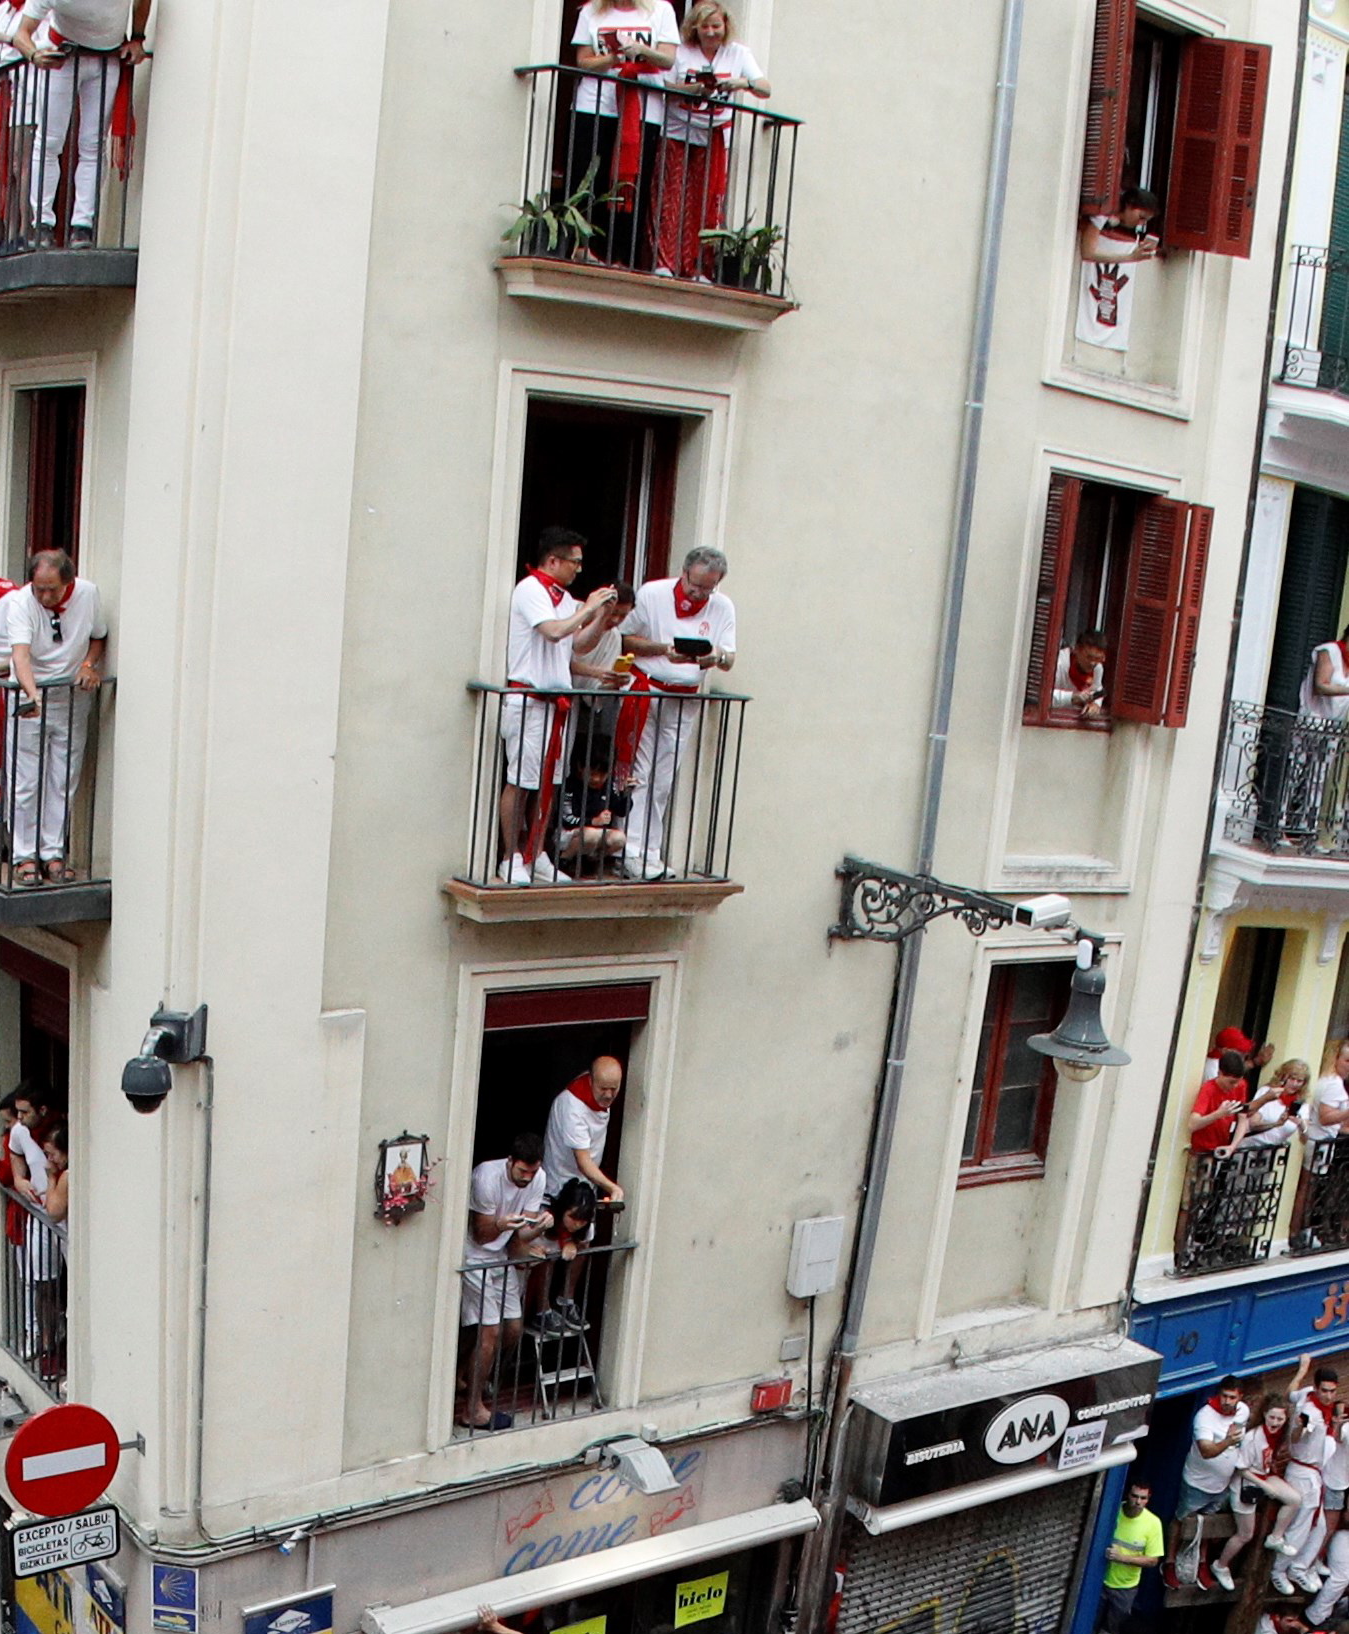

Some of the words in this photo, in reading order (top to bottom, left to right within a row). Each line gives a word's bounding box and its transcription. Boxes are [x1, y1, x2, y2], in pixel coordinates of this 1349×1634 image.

[1076, 1394, 1152, 1421] COMPLEMENTOS
[997, 1410, 1057, 1452] ANA
[904, 1439, 966, 1466] BISUTERIA
[568, 1451, 702, 1511] coe
[18, 1522, 65, 1544] EXCEPTO
[504, 1515, 639, 1577] come
[18, 1537, 69, 1557] BICICLETAS
[19, 1551, 69, 1571] BIZIKLETAK
[678, 1586, 723, 1610] hielo
